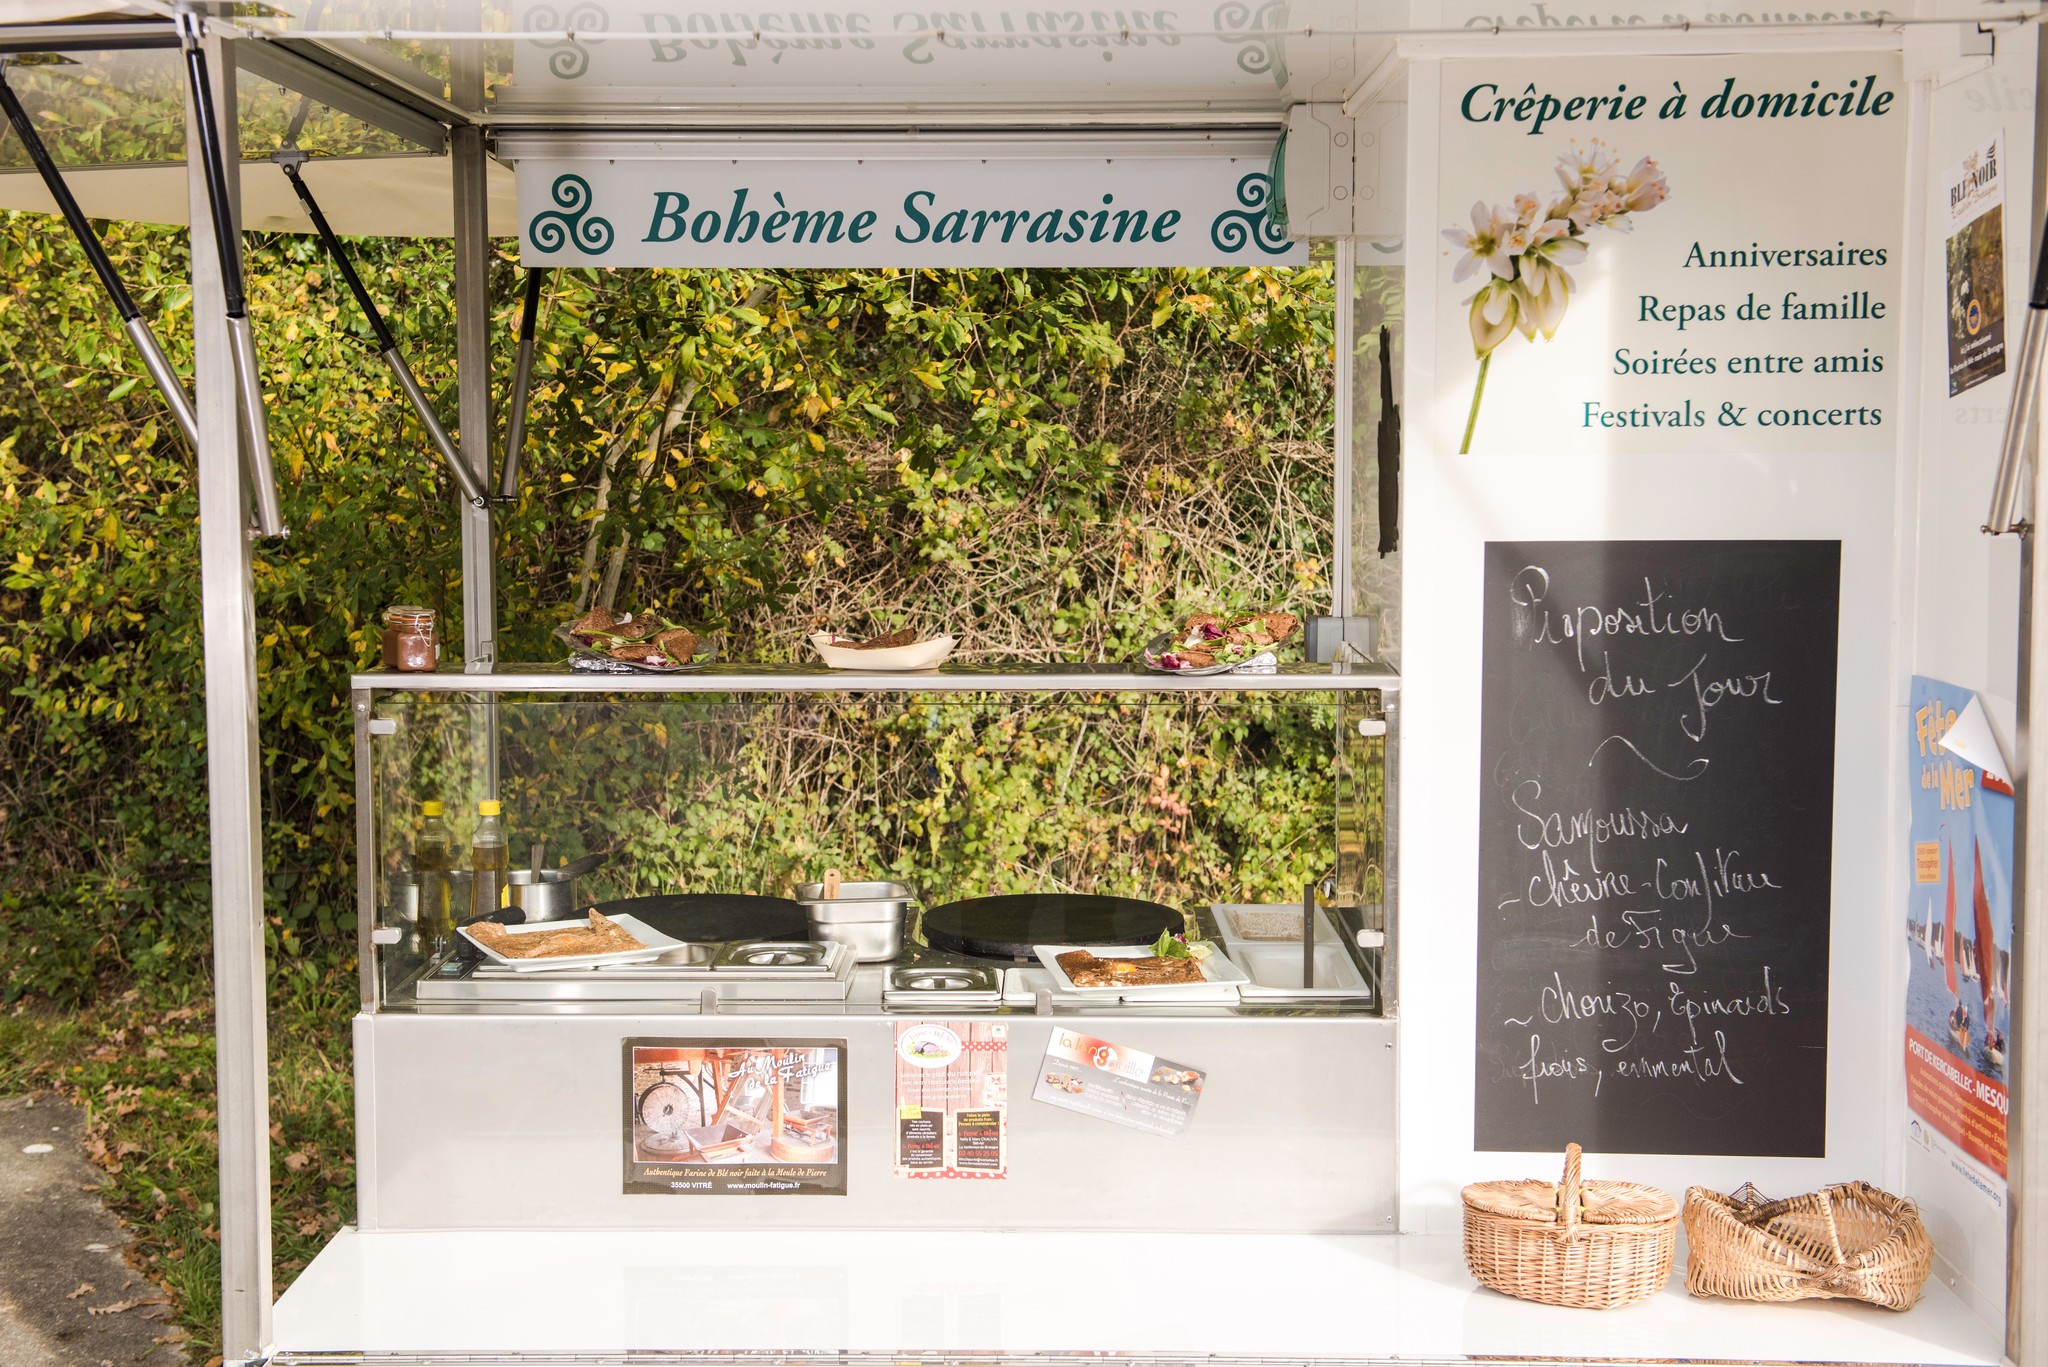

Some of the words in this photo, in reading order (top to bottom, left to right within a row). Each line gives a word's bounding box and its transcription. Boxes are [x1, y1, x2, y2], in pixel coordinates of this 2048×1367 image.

[1461, 83, 1647, 135] Crêperie
[1659, 81, 1687, 120] à
[1701, 75, 1894, 119] domicile
[641, 188, 877, 243] Bohème
[894, 190, 1181, 243] Sarrasine
[1683, 241, 1888, 268] Anniversaires
[1638, 295, 1726, 330] Repas
[1736, 292, 1771, 321] de
[1782, 291, 1887, 321] famille
[1613, 347, 1717, 376] Soirées
[1727, 354, 1804, 375] entre
[1814, 347, 1884, 374] amis
[1582, 400, 1706, 428] Festivals
[1718, 402, 1748, 427] &
[1757, 403, 1882, 427] concerts
[1588, 651, 1656, 706] du
[1921, 764, 1931, 789] de
[1931, 762, 1939, 789] la
[1939, 759, 1975, 811] Mer
[1512, 779, 1689, 874] Samoussa
[1058, 1032, 1073, 1049] la
[1909, 1038, 1925, 1060] PORT
[1924, 1049, 1933, 1066] DE
[727, 1061, 753, 1079] Au
[755, 1053, 805, 1073] Moulin
[749, 1077, 761, 1090] de
[765, 1074, 778, 1086] la
[777, 1062, 832, 1083] Fatigue
[643, 1167, 683, 1178] Authentique
[683, 1168, 706, 1177] Farine
[707, 1168, 716, 1177] de
[716, 1168, 729, 1177] Blé
[729, 1168, 743, 1177] noir
[743, 1168, 760, 1179] faite
[761, 1169, 766, 1177] à
[767, 1168, 775, 1177] la
[775, 1168, 796, 1177] Meule
[797, 1167, 805, 1177] de
[805, 1168, 827, 1177] Pierre
[692, 1180, 712, 1189] VITRÉ
[727, 1182, 800, 1190] www.moulin-fatigue.fr
